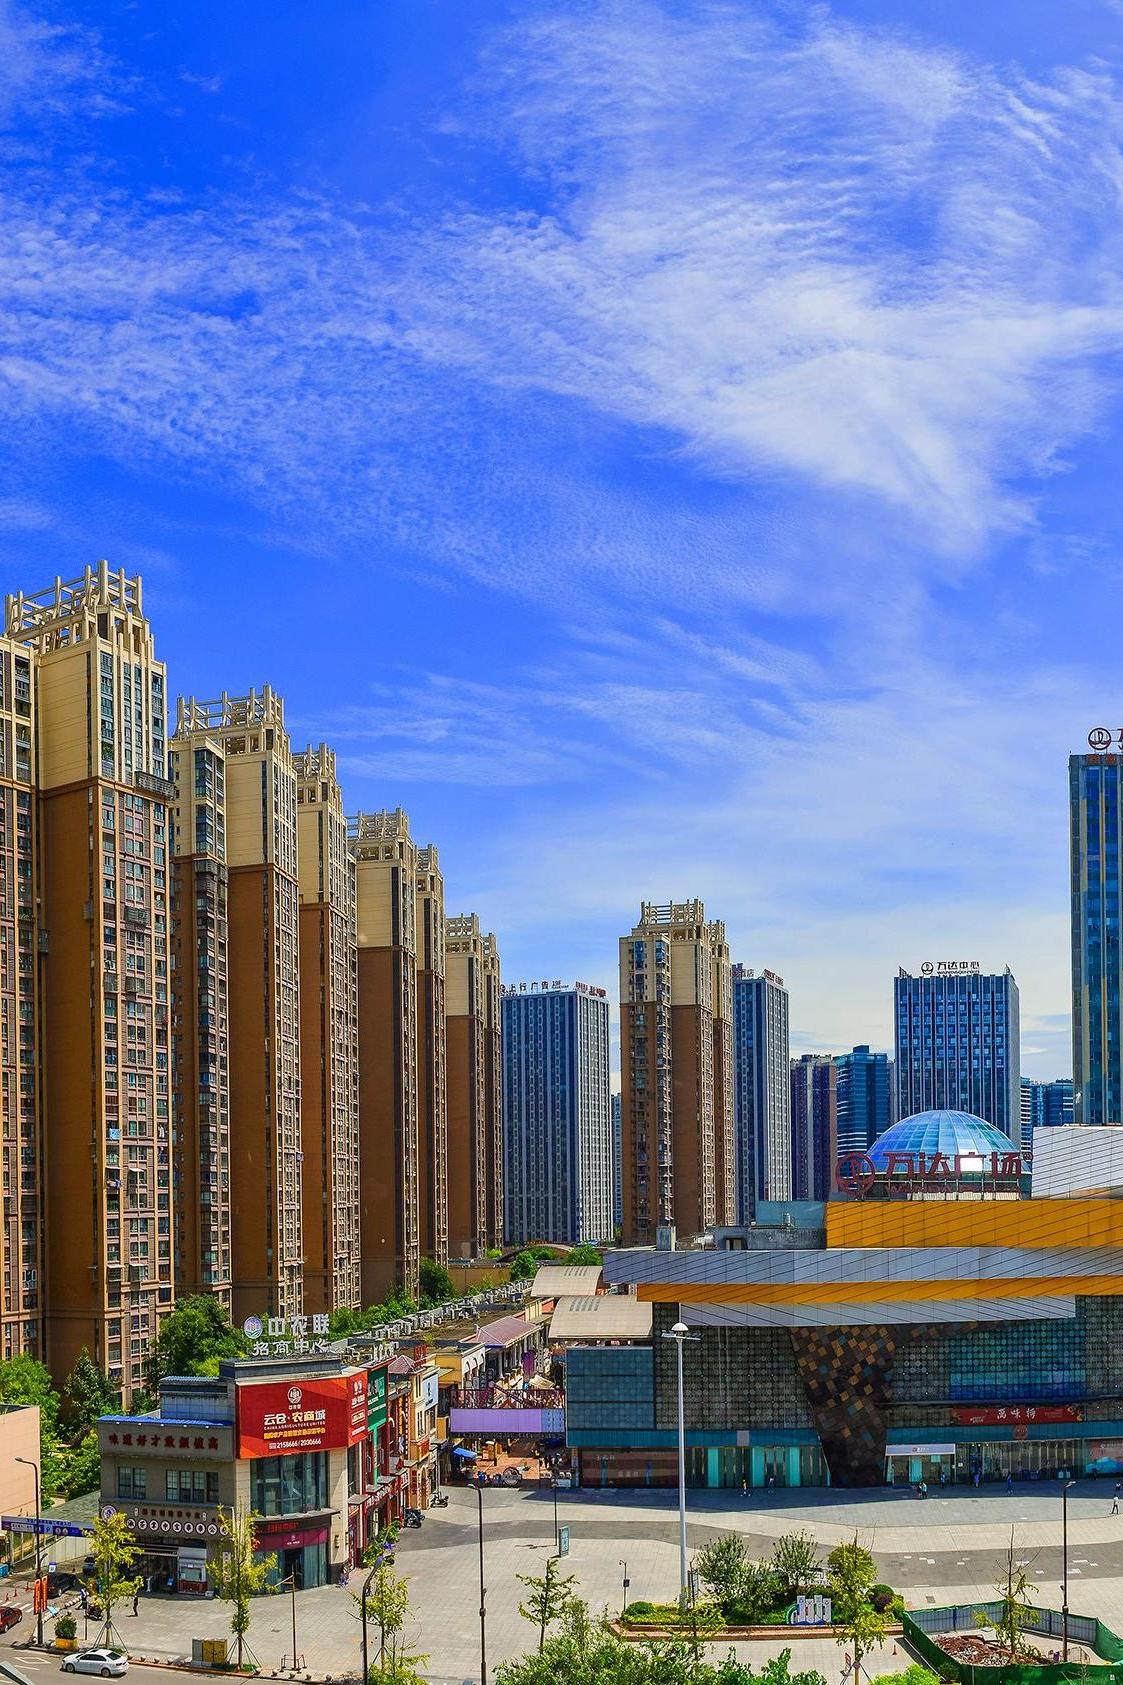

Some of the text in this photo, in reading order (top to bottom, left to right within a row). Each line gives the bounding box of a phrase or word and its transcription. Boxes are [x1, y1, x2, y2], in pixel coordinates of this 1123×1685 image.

[937, 961, 980, 971] 万达中心
[883, 1151, 1022, 1179] 万达广场
[268, 1313, 330, 1337] 中农联
[252, 1338, 328, 1356] 招商中心
